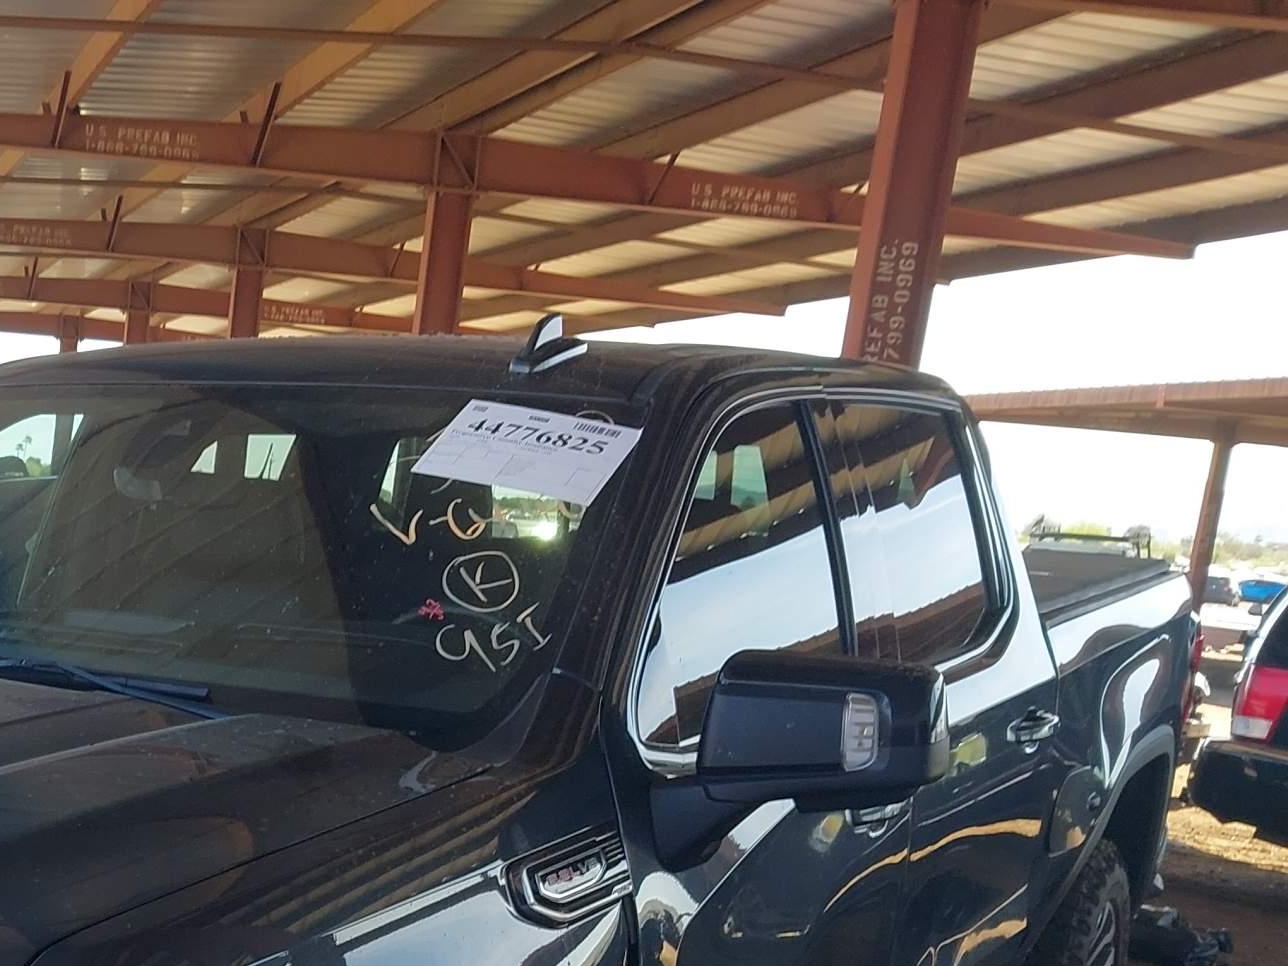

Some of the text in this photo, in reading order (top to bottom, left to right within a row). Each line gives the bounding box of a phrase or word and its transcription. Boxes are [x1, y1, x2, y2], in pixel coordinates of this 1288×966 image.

[862, 239, 899, 362] REFAB INC.
[882, 241, 919, 360] 799-0969
[468, 418, 609, 455] 44776825
